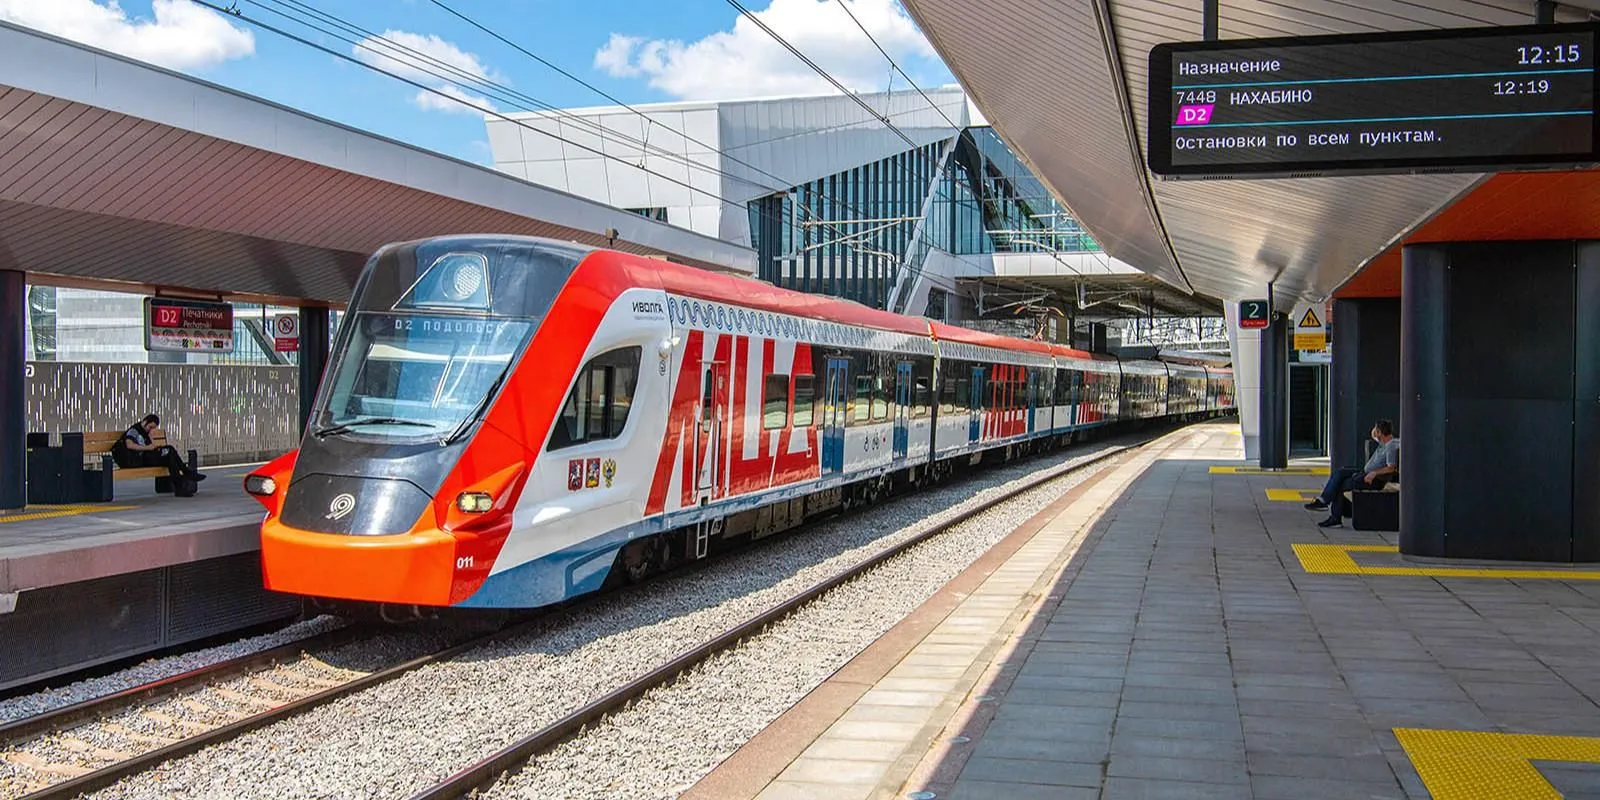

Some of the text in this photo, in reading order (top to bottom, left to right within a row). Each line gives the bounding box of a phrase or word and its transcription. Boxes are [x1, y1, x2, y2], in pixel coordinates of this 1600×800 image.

[1517, 45, 1580, 65] 12:15
[1179, 60, 1281, 76] Назначение
[1493, 79, 1549, 96] 12:19
[1176, 90, 1217, 104] 7448
[1230, 89, 1312, 105] НАХАБИНО
[1183, 108, 1207, 122] D2
[1175, 130, 1443, 150] Остановки по всем пунктам.
[160, 308, 223, 323] D2 Печатники
[632, 302, 664, 313] ИВОЛГА
[1248, 302, 1260, 318] 2
[456, 555, 474, 569] 011
